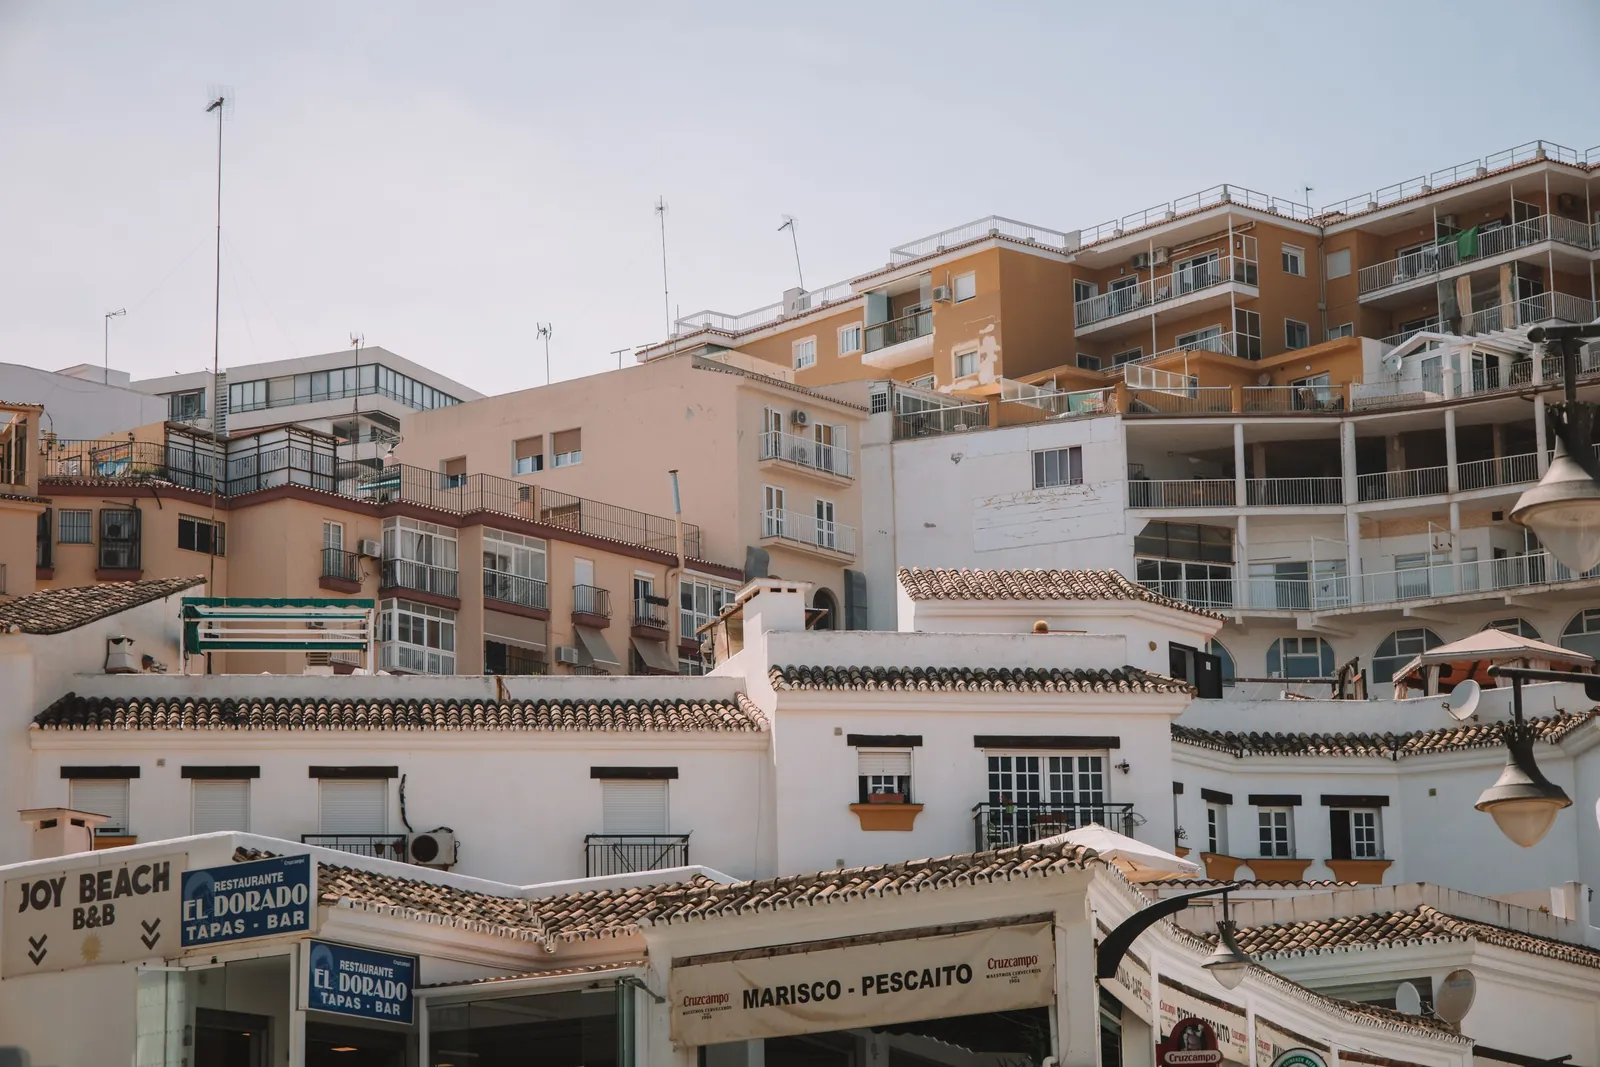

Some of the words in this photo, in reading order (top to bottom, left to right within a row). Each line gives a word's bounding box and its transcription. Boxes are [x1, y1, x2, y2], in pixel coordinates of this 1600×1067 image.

[18, 876, 67, 913] JOY
[79, 861, 171, 904] BEACH
[214, 872, 284, 892] RESTAURANTE
[183, 898, 209, 922] EL
[214, 883, 308, 917] DORADO
[72, 903, 116, 930] B&B
[186, 918, 245, 940] TAPAS
[267, 910, 305, 929] BAR
[339, 959, 394, 978] RESTAURANTE
[987, 954, 1038, 970] Cruzcampo
[314, 967, 333, 990] EL
[339, 972, 408, 1002] DORADO
[742, 979, 842, 1010] MARISCO
[861, 963, 973, 997] PESCAITO
[320, 991, 361, 1010] TAPAS
[375, 1000, 401, 1016] BAR
[683, 993, 730, 1007] Cruzcampo
[1169, 1053, 1217, 1063] Cruzcampo
